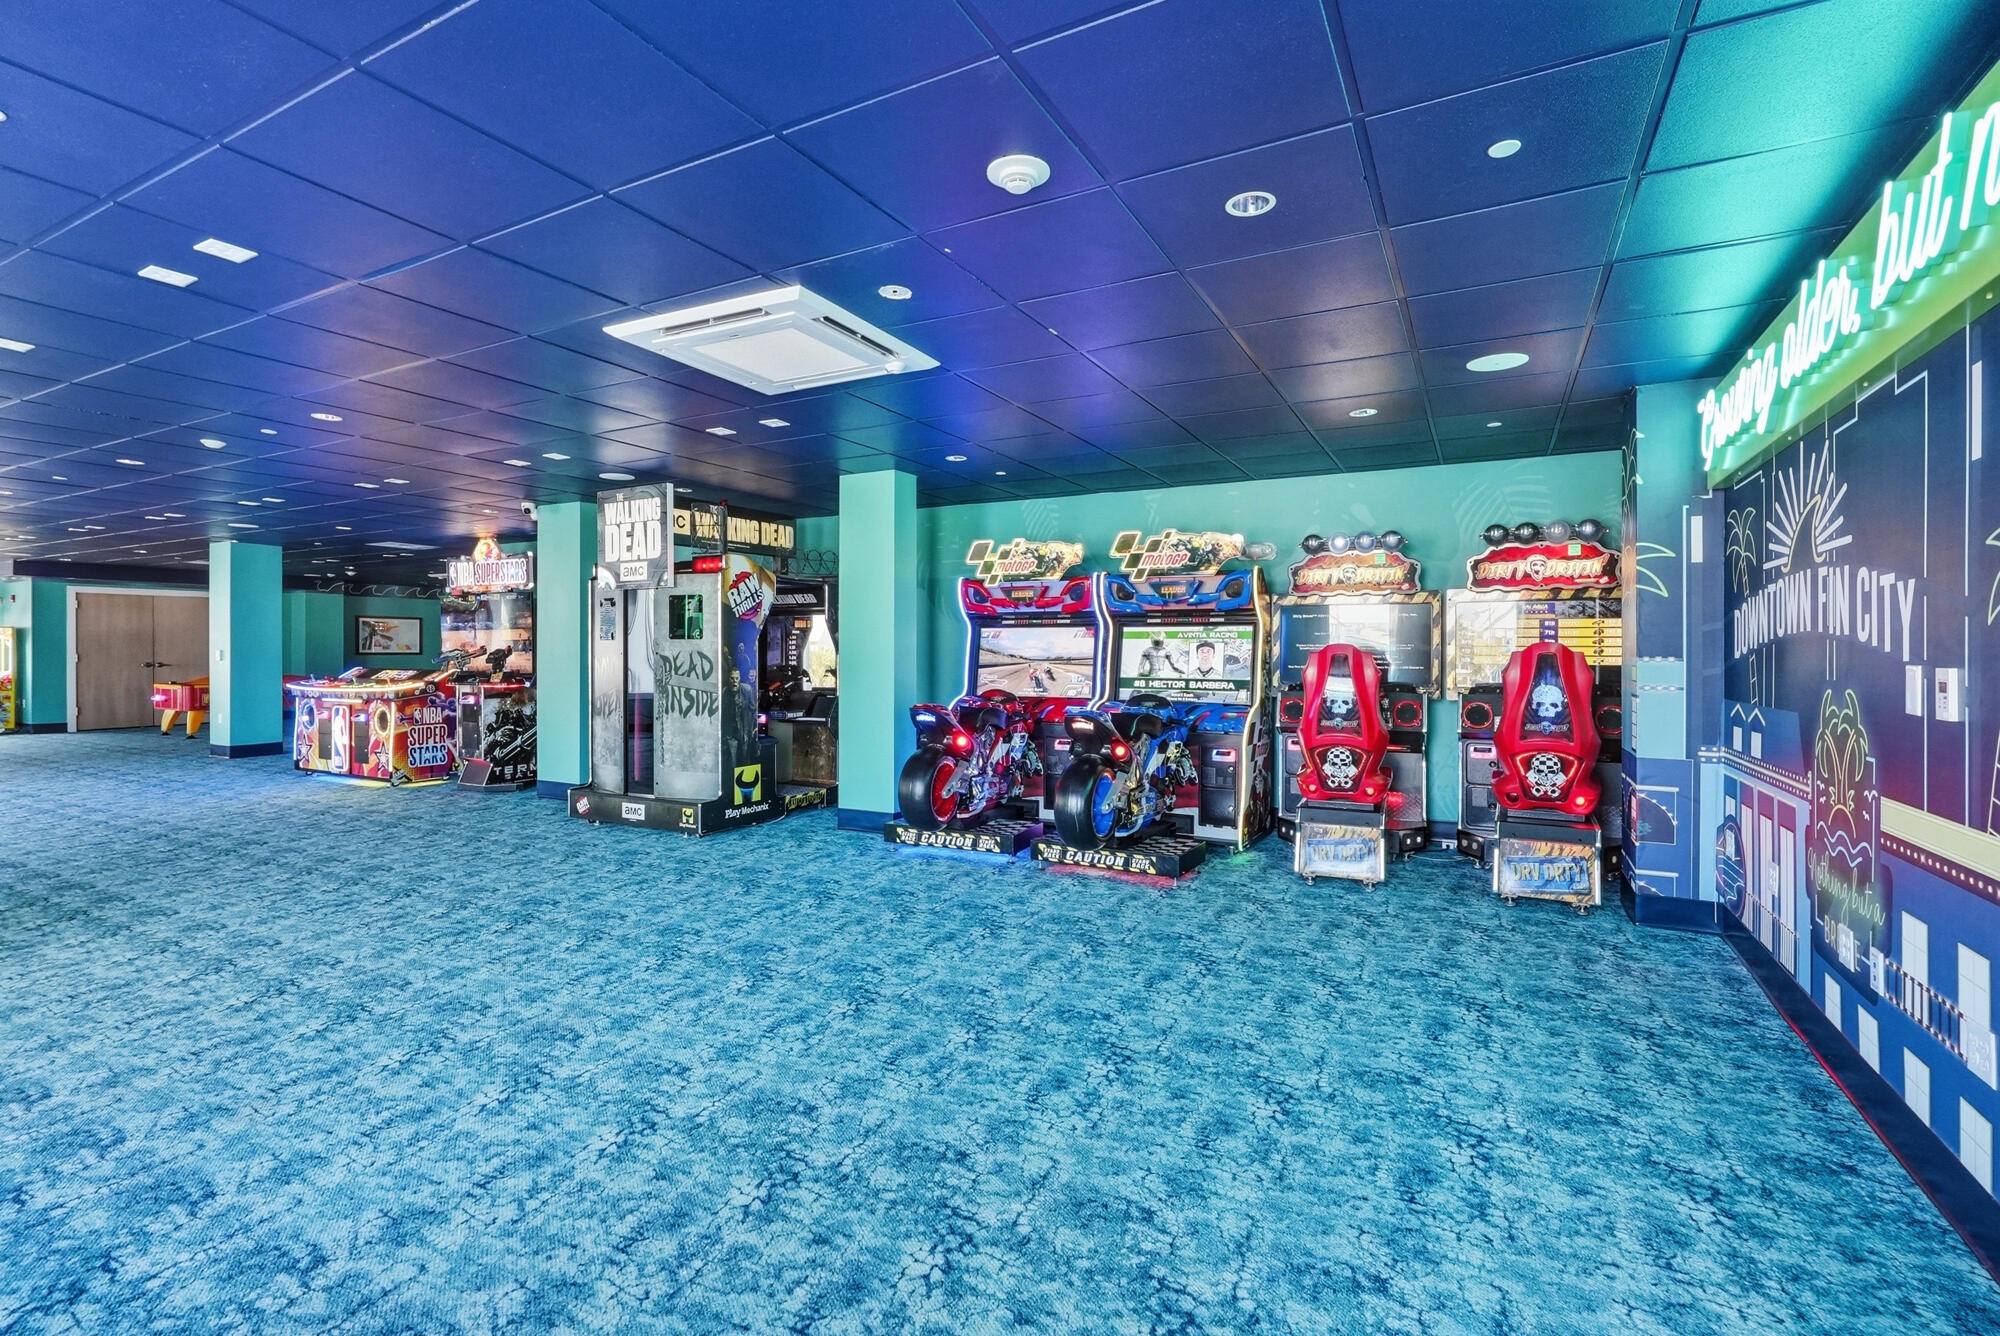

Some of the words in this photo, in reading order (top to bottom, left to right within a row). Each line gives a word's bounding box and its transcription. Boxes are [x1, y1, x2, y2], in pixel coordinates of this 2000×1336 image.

[1780, 259, 1861, 389] older,
[1870, 112, 1953, 309] but
[604, 497, 661, 525] WALKING
[605, 520, 662, 562] DEAD
[761, 522, 794, 548] DEAD
[457, 561, 475, 587] NBA
[1297, 569, 1341, 586] DIRTY
[1476, 561, 1526, 580] DIRTY
[727, 573, 760, 608] RAW
[732, 589, 764, 618] THRILLS
[1734, 568, 1812, 659] DOWNTOWN
[1817, 565, 1849, 636] FIN
[1856, 566, 1916, 662] CITY
[660, 651, 713, 681] DEAD
[1149, 681, 1186, 689] HECTOR
[1189, 681, 1235, 690] BARBERA
[664, 685, 719, 719] INSIDE
[423, 707, 442, 724] NBA
[408, 725, 447, 747] SUPER
[408, 744, 447, 767] STARS
[725, 807, 742, 819] Play
[921, 833, 973, 847] CAUTION
[1065, 850, 1125, 866] CAUTION
[1545, 863, 1582, 882] DRTY
[1807, 847, 1851, 926] Nothing
[1851, 867, 1873, 918] but
[1873, 903, 1886, 926] a
